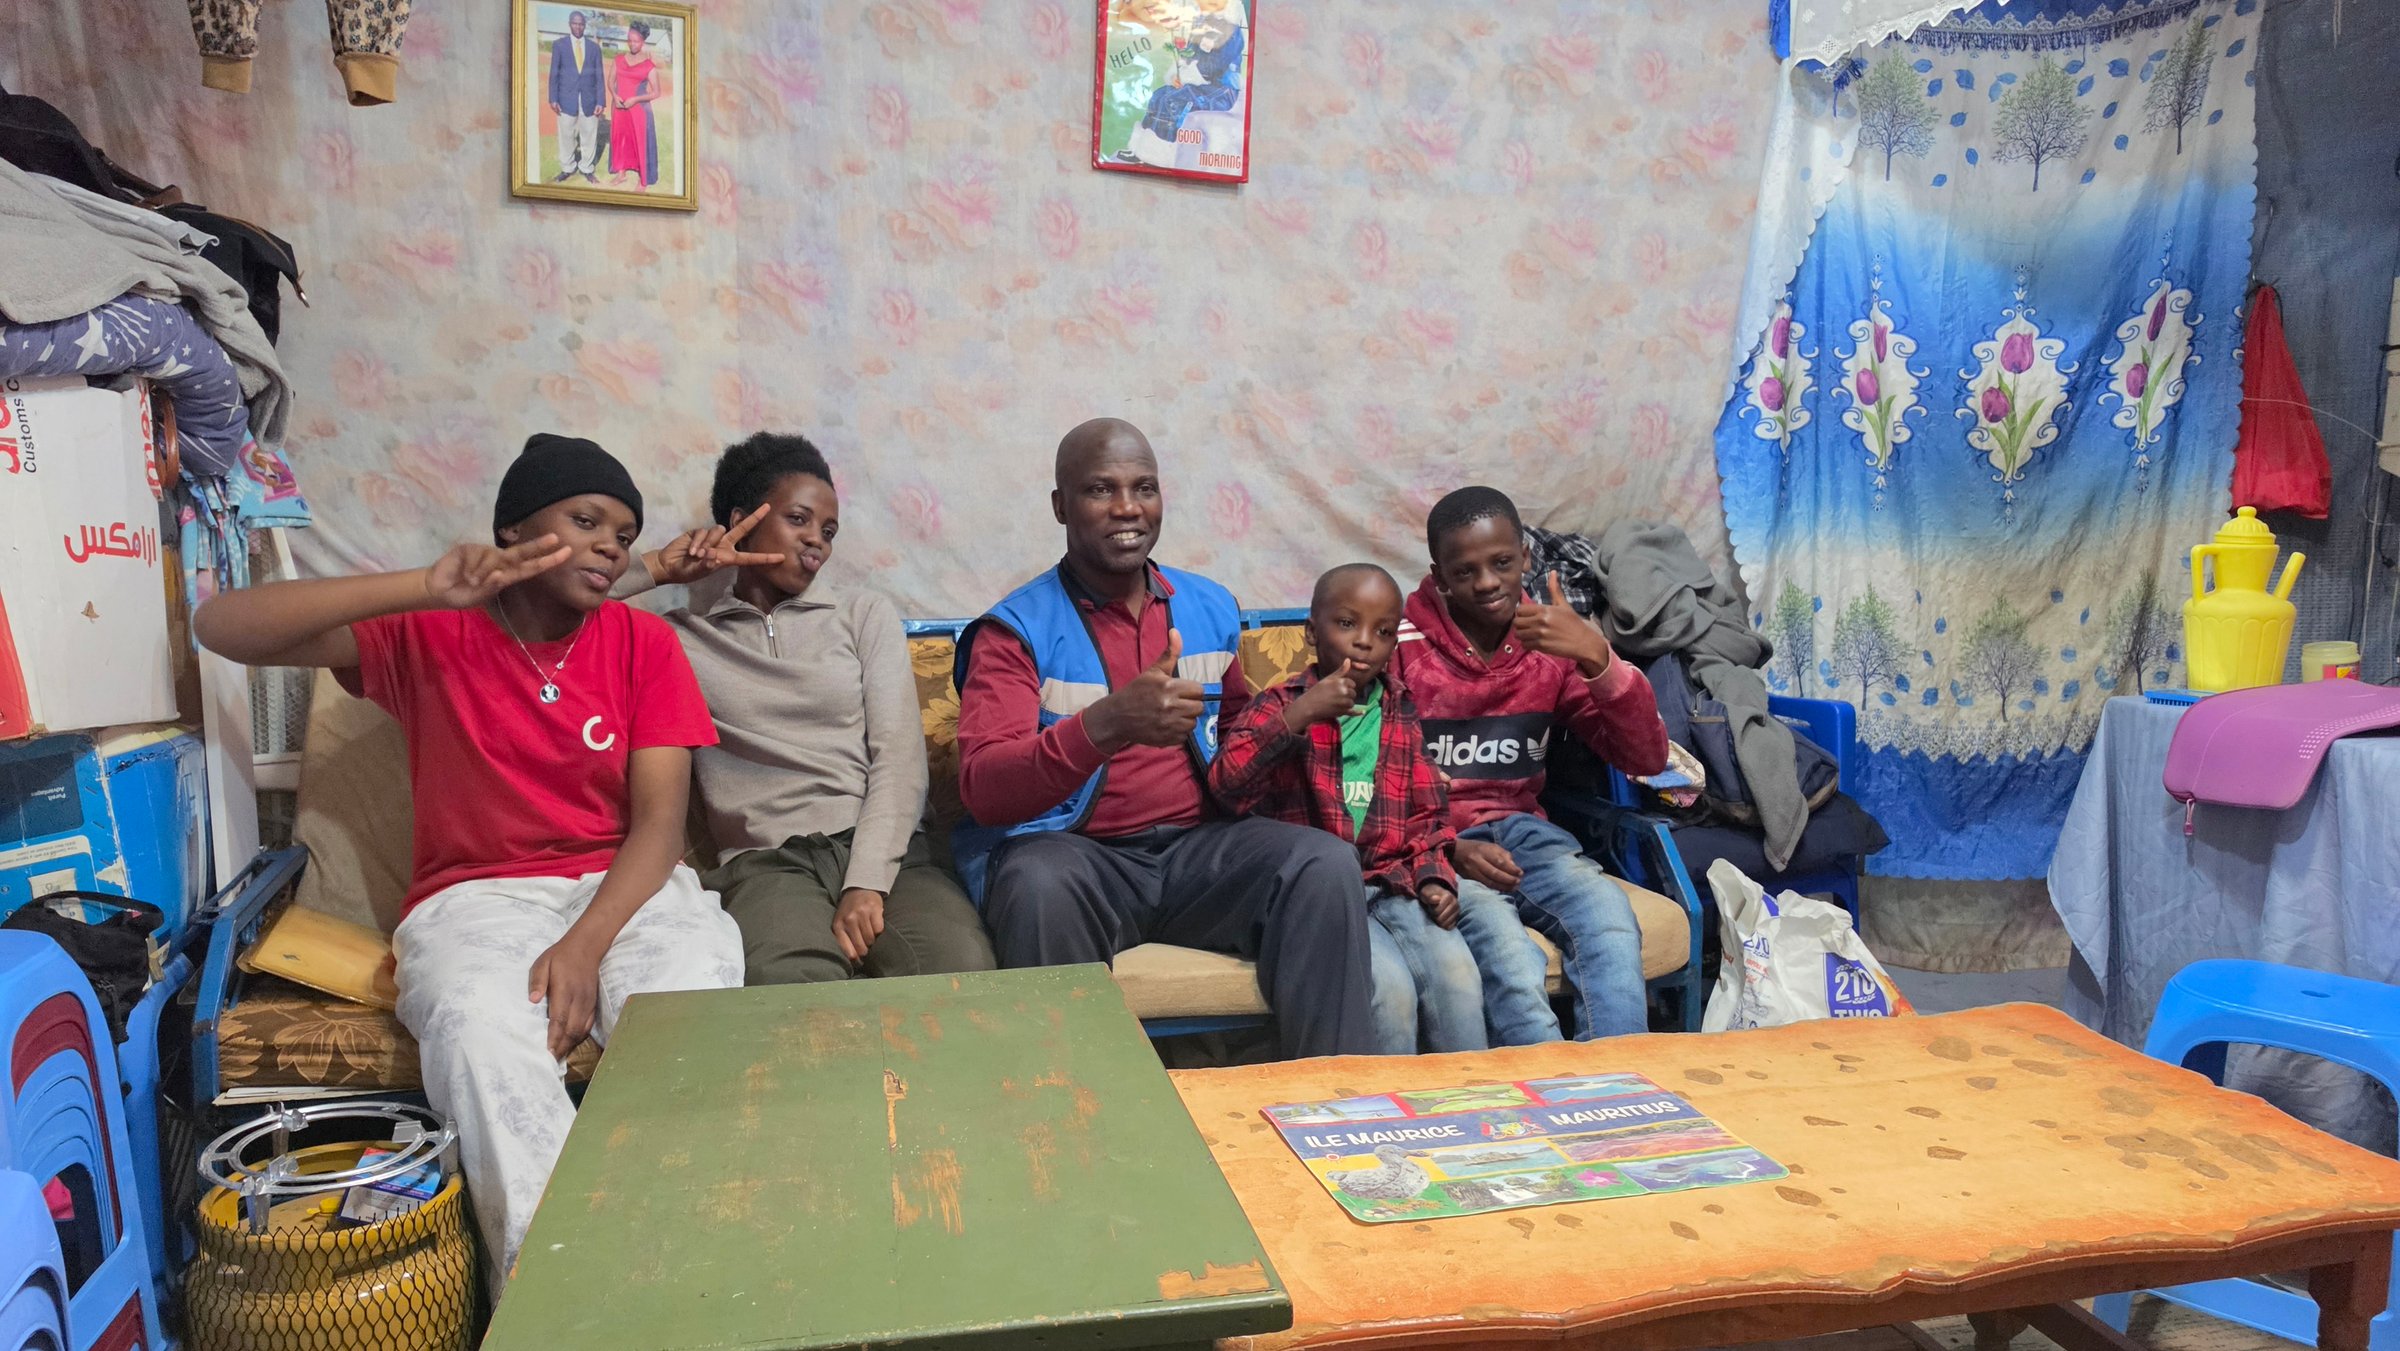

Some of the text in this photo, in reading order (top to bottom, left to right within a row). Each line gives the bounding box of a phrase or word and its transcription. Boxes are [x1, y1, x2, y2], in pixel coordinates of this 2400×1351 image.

[1109, 37, 1152, 69] HELLO
[1178, 128, 1202, 145] GOOD
[14, 398, 37, 474] Customs
[1426, 734, 1520, 766] didas
[1834, 967, 1876, 1002] 210
[1547, 1100, 1681, 1126] MAURITIUS
[1304, 1124, 1466, 1148] ILE MAURICE
